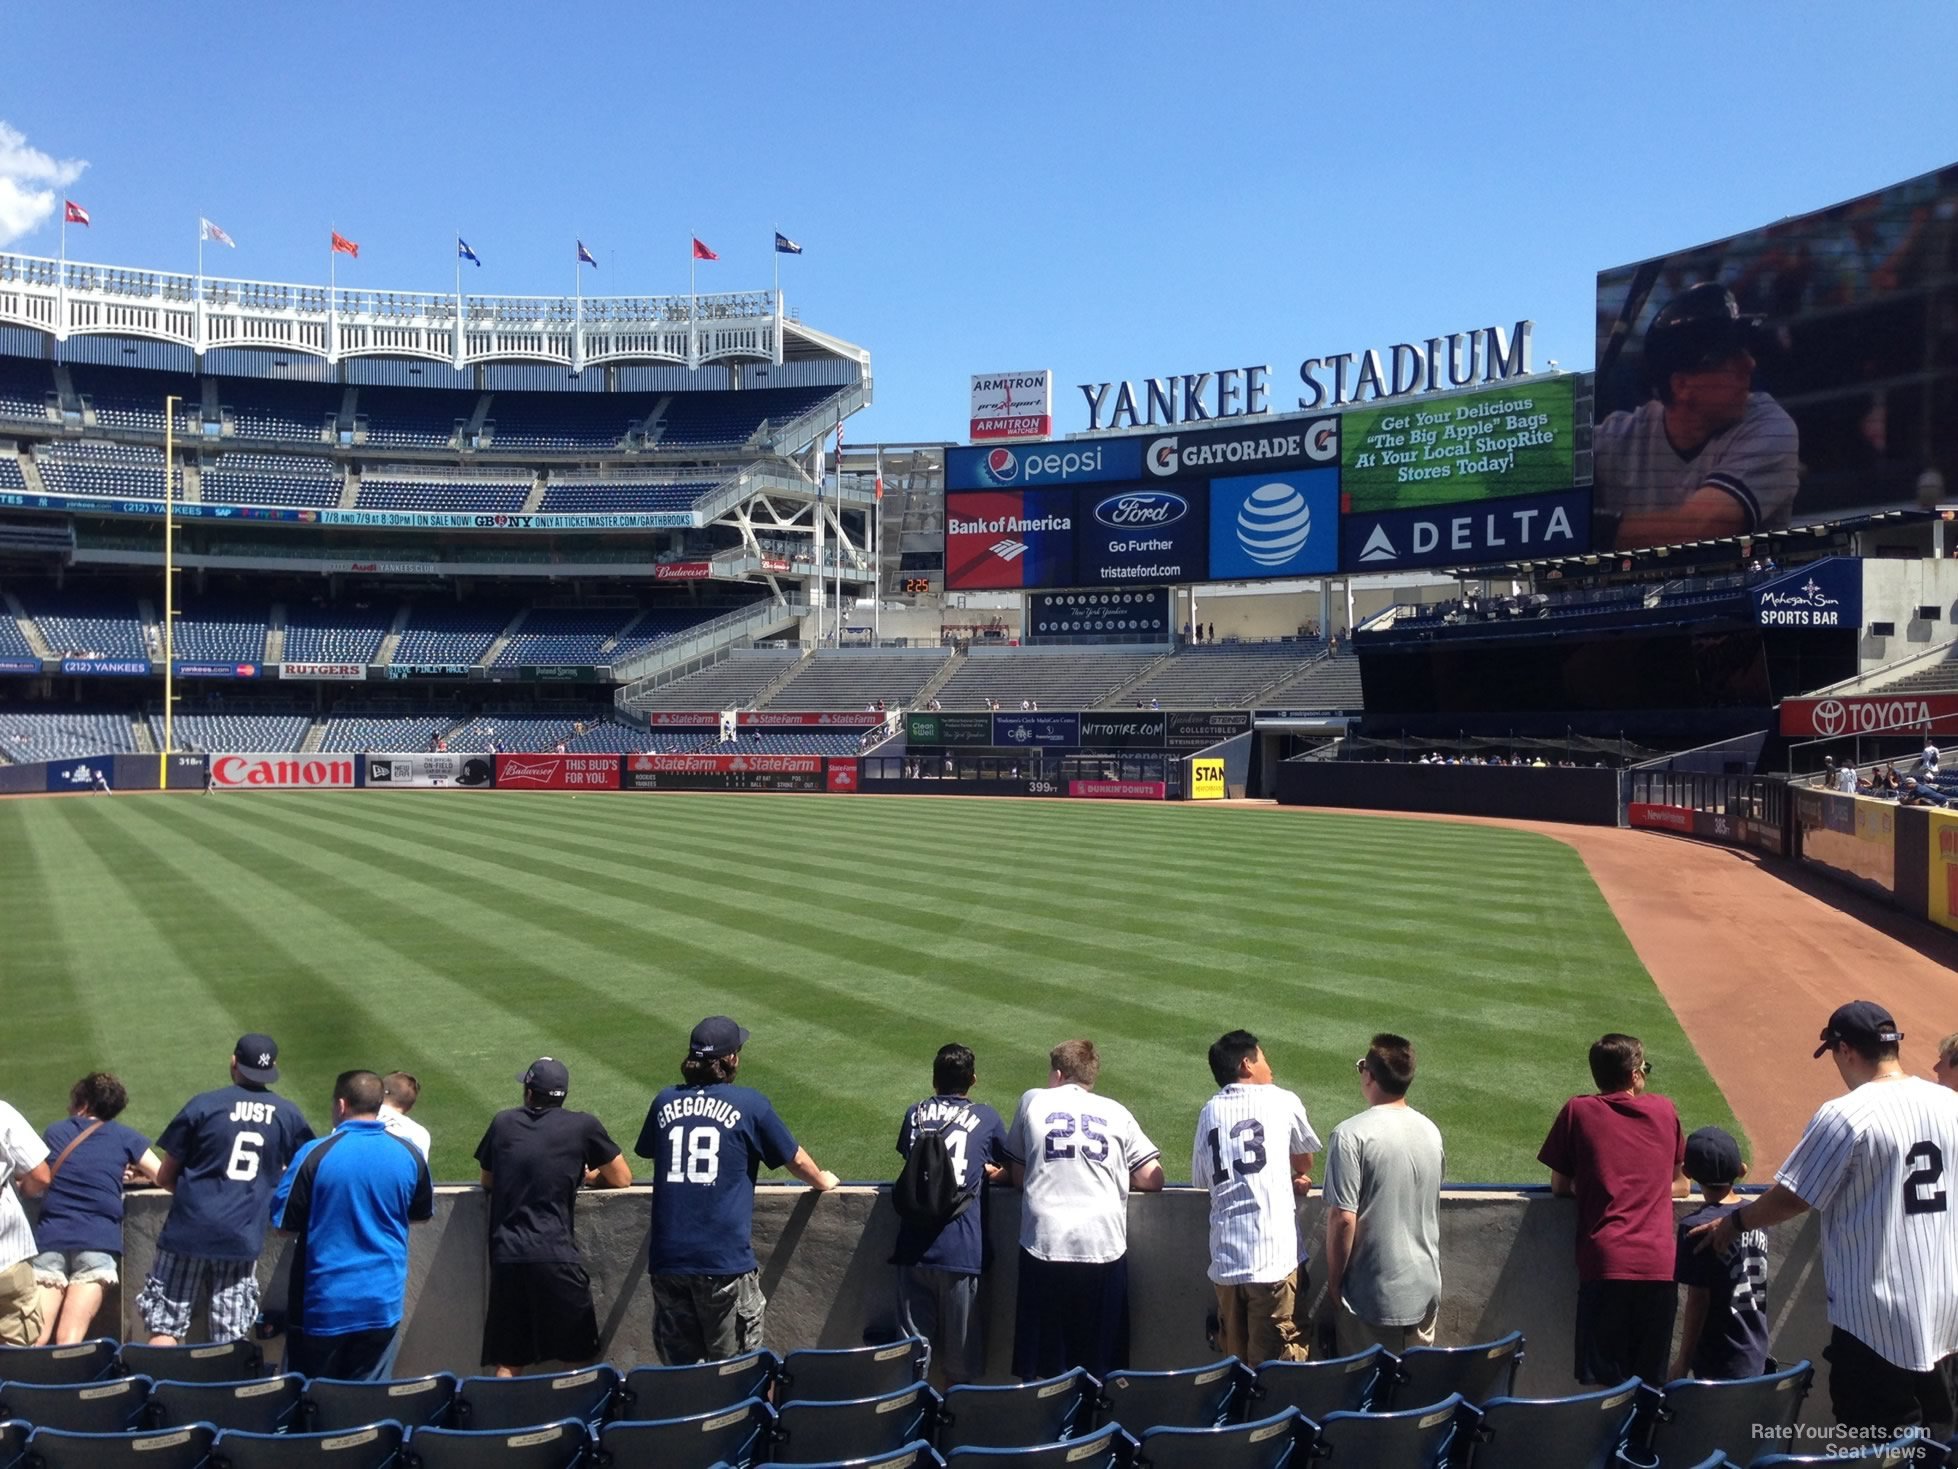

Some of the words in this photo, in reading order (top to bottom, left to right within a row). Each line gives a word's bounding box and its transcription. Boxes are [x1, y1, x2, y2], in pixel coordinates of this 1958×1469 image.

[1077, 364, 1273, 430] YANKEE
[1299, 320, 1536, 409] STADIUM
[974, 377, 1044, 391] ARMITRON
[1381, 416, 1410, 430] Get
[1415, 412, 1451, 426] Your
[1456, 398, 1533, 420] Delicious
[977, 418, 1040, 431] ARMITRON
[1007, 427, 1038, 435] WATCHES
[1410, 429, 1437, 447] Big
[1506, 413, 1548, 432] Bags
[1182, 435, 1300, 466] GATORADE
[1355, 453, 1376, 468] At
[1382, 450, 1417, 466] Your
[1424, 441, 1471, 460] Local
[1476, 429, 1554, 453] ShopRite
[1025, 446, 1102, 480] pepsi
[1398, 464, 1451, 482] Stores
[1456, 453, 1515, 474] Today!
[123, 503, 149, 513] (212)
[215, 507, 231, 517] SAP
[1112, 497, 1170, 523] Ford
[325, 512, 339, 523] 7/8
[341, 514, 354, 523] AND
[356, 513, 370, 524] 7/9
[372, 515, 379, 524] AT
[417, 515, 428, 525] ON
[430, 515, 449, 526] SALE
[451, 516, 472, 526] NOW!
[508, 516, 533, 527] NY
[535, 515, 553, 527] ONLY
[555, 515, 564, 526] AT
[564, 514, 690, 527] TICKETMASTER.COM/GARTHBROOKS
[948, 519, 988, 535] Bank
[989, 516, 1006, 532] of
[1007, 515, 1071, 532] America
[1413, 506, 1574, 554] DELTA
[1109, 541, 1127, 552] Go
[1129, 539, 1173, 551] Further
[352, 563, 377, 571] Audi
[380, 564, 414, 572] YANKEES
[658, 565, 709, 577] Budweiser
[1100, 564, 1181, 578] tristateford.com
[1761, 592, 1813, 607] Mohegan
[1814, 593, 1839, 607] Sun
[1761, 610, 1809, 625] SPORTS
[1813, 611, 1838, 625] BAR
[65, 662, 91, 672] (212)
[94, 663, 145, 673] YANKEES
[180, 666, 230, 674] yankees.com
[285, 665, 361, 676] RUTGERS
[388, 664, 411, 673] STEVE
[416, 664, 443, 673] FINLEY
[1849, 702, 1932, 731] TOYOTA
[1082, 723, 1163, 736] NITTOTIRE.COM
[212, 756, 352, 784] Canon
[506, 765, 552, 776] Budweiser
[565, 760, 586, 770] THIS
[589, 759, 618, 770] BUD'S
[565, 773, 583, 783] FOR
[585, 773, 608, 784] YOU.
[1122, 785, 1154, 794] DONUTS
[230, 1101, 277, 1125] JUST
[657, 1095, 742, 1129] GREGORIUS
[1045, 1112, 1108, 1162] 25
[226, 1131, 265, 1182] 6
[666, 1126, 720, 1183] 18
[1208, 1118, 1268, 1186] 13
[1903, 1140, 1947, 1215] 2
